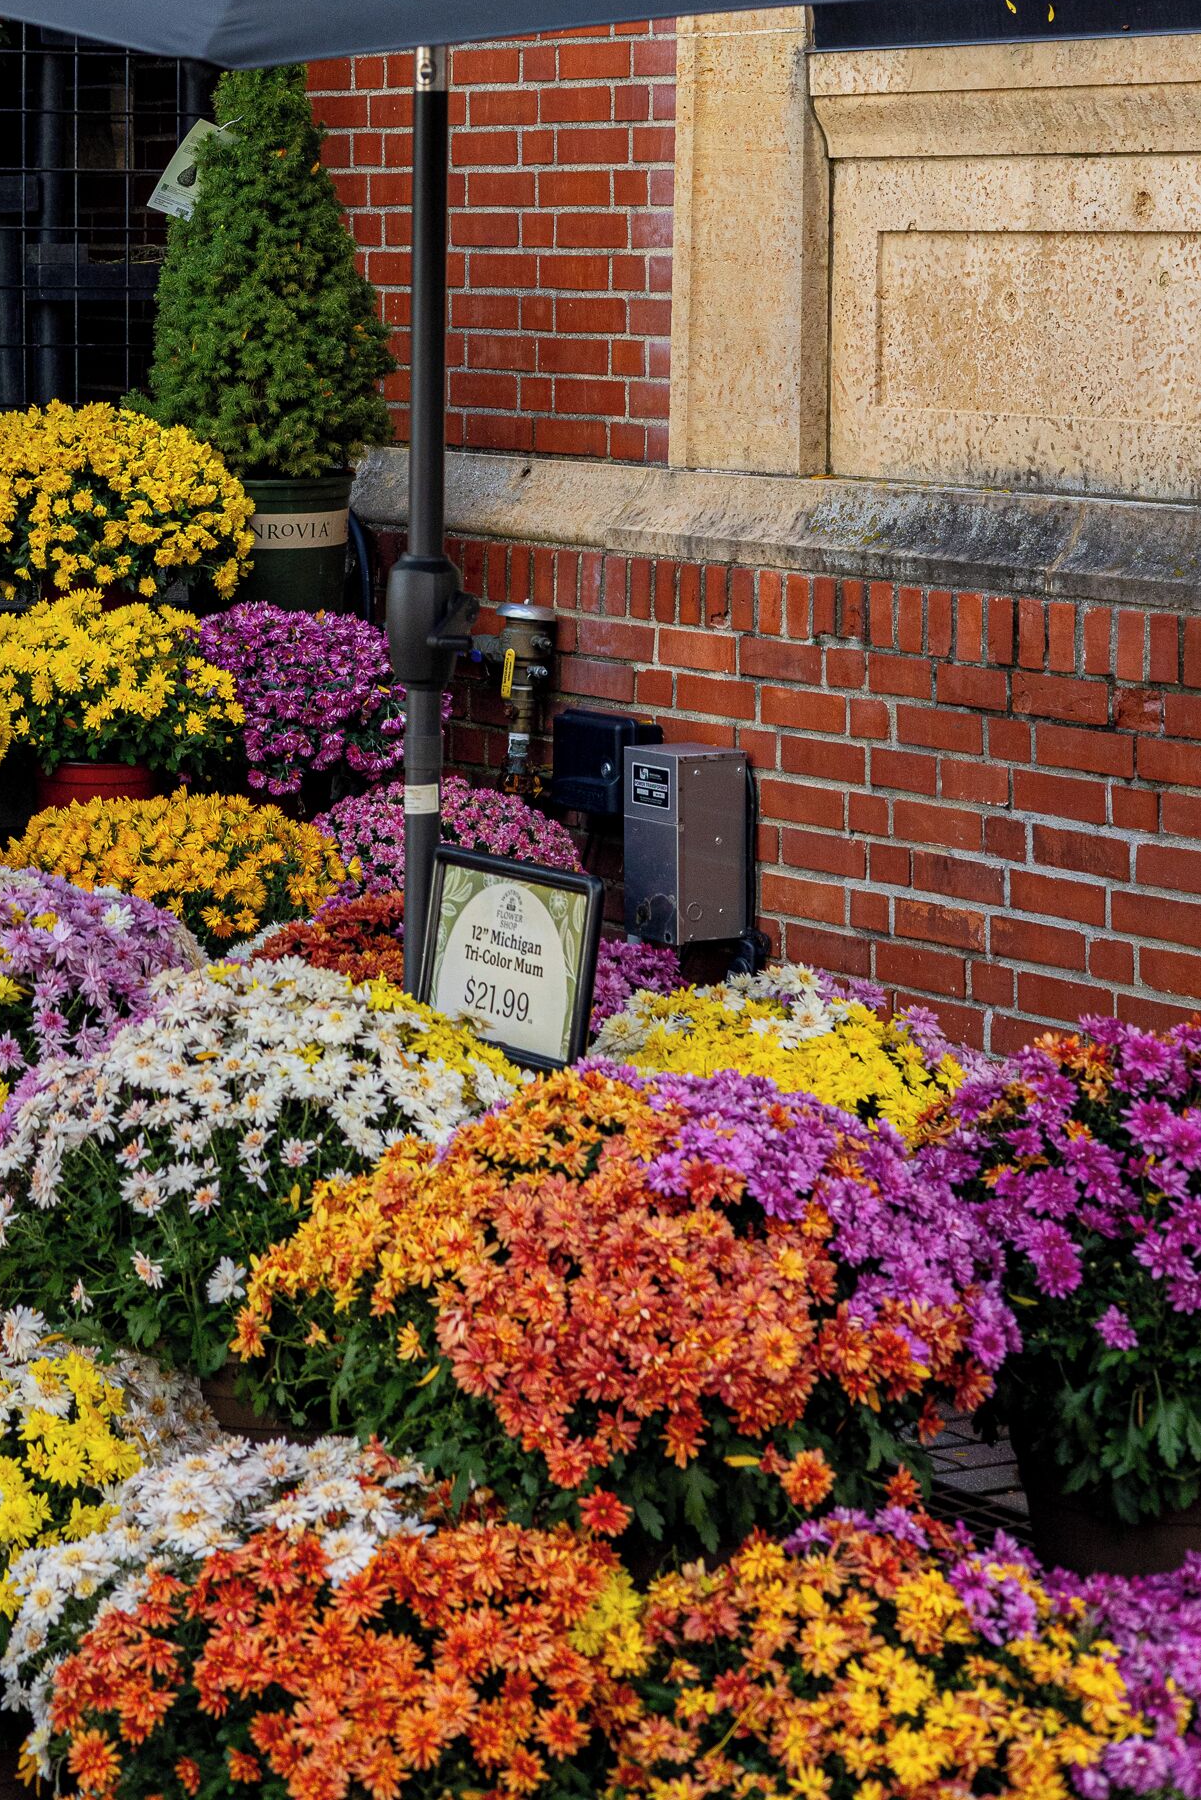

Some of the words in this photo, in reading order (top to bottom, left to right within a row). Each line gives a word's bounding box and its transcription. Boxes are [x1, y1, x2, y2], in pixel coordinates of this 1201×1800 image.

[496, 909, 523, 923] FLOWER
[500, 920, 517, 930] SHOP
[490, 929, 541, 956] Michigan
[464, 944, 512, 970] Tri-Color
[513, 957, 544, 978] Mum
[464, 976, 530, 1022] $21.99
